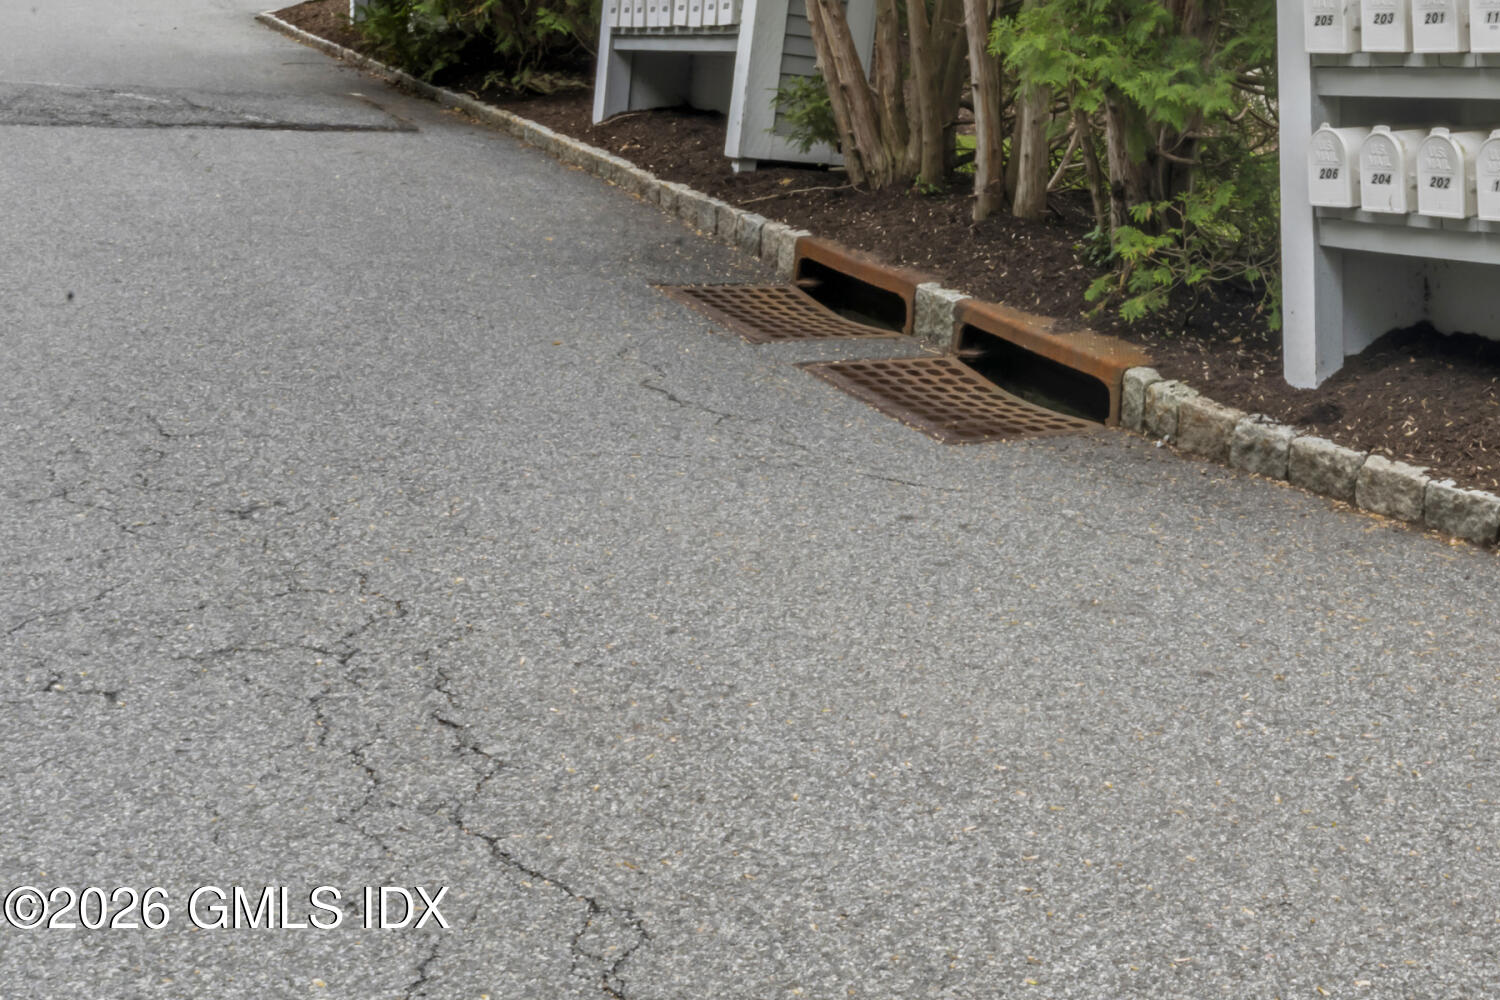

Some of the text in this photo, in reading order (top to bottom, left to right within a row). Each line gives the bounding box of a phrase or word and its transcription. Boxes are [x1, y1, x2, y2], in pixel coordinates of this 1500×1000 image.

[1314, 15, 1334, 26] 205
[1374, 12, 1394, 24] 203
[1425, 12, 1445, 24] 201
[1319, 168, 1339, 179] 206
[1371, 173, 1392, 185] 204
[1429, 176, 1450, 189] 202
